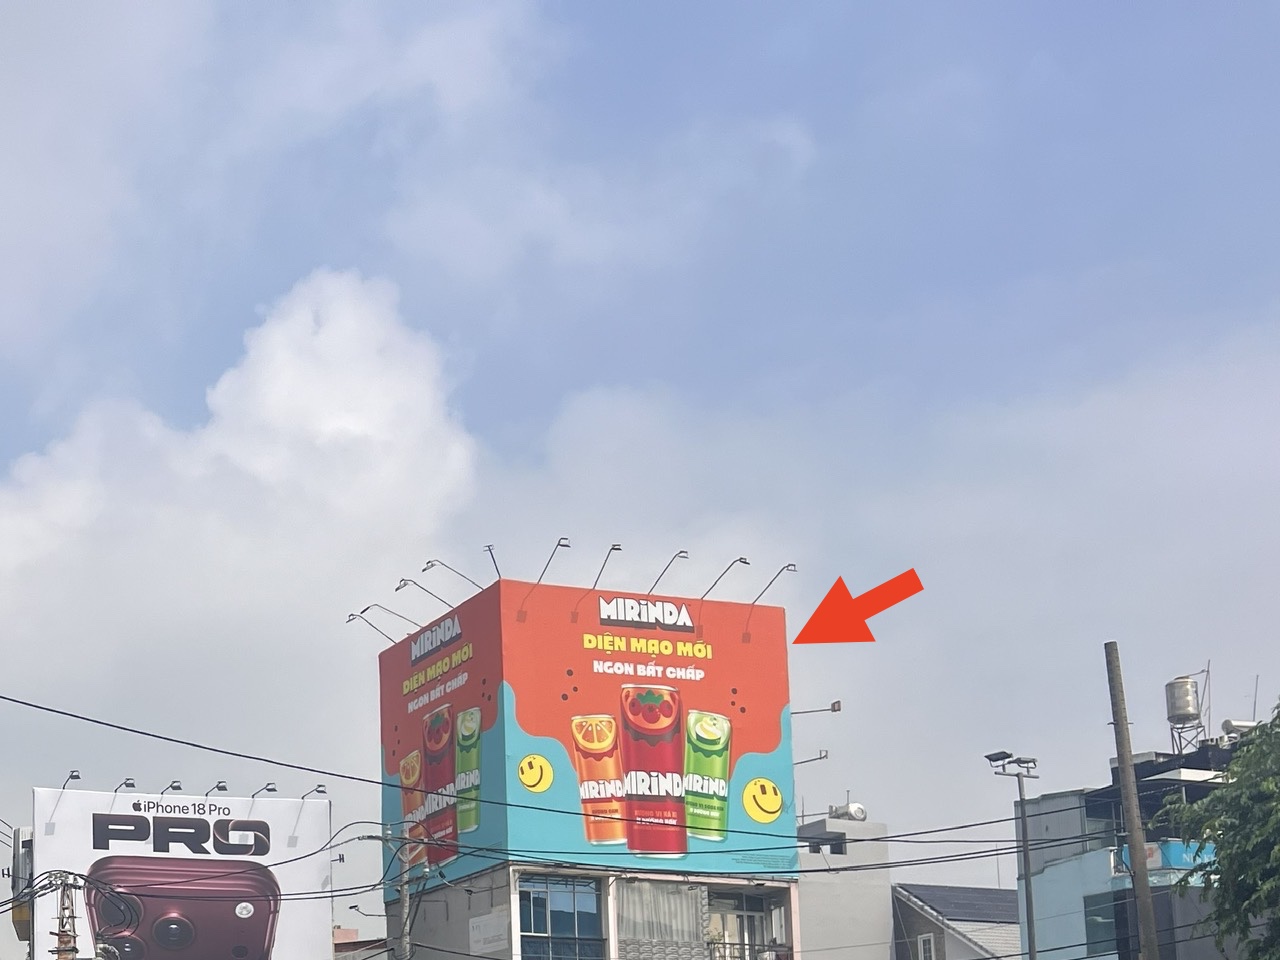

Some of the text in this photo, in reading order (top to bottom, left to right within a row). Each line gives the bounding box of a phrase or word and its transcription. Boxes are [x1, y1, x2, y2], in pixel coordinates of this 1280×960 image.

[583, 632, 713, 659] DIỆN MẠO MỚI
[426, 657, 450, 680] MẠO
[593, 660, 705, 681] NGON BẤT CHẤP
[143, 801, 231, 817] iPhone 18 Pro
[92, 812, 271, 856] PRO
